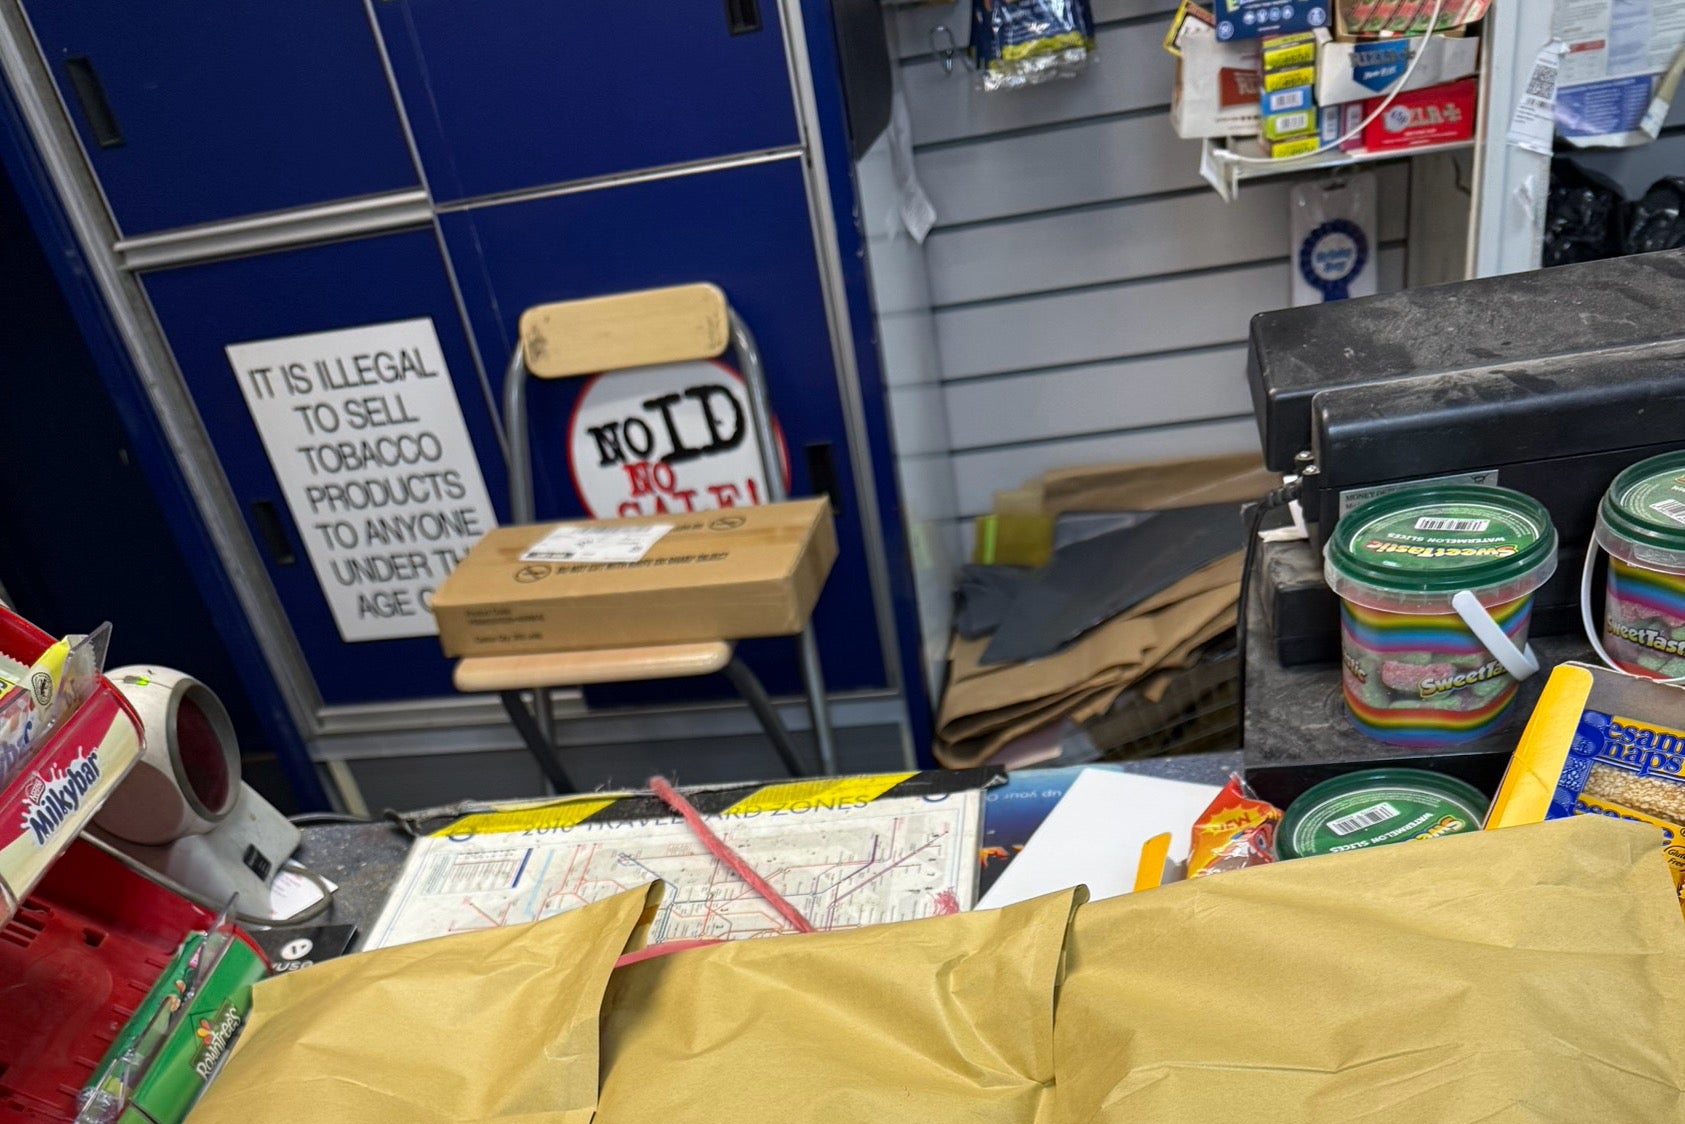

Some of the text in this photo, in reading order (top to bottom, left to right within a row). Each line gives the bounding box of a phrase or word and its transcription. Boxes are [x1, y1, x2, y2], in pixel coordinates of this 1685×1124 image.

[249, 348, 439, 400] IT IS ILLEGAL
[295, 393, 420, 436] TO SELL
[587, 384, 747, 468] NO ID
[298, 431, 443, 476] TOBACCO
[305, 470, 467, 513] PRODUCTS
[622, 459, 675, 498] NO
[314, 519, 358, 551] TO
[364, 508, 486, 546] ANYONE
[332, 545, 467, 587] UNDER TH
[357, 589, 415, 620] AGE
[28, 750, 102, 846] Milkybar
[771, 793, 869, 817] ZONES
